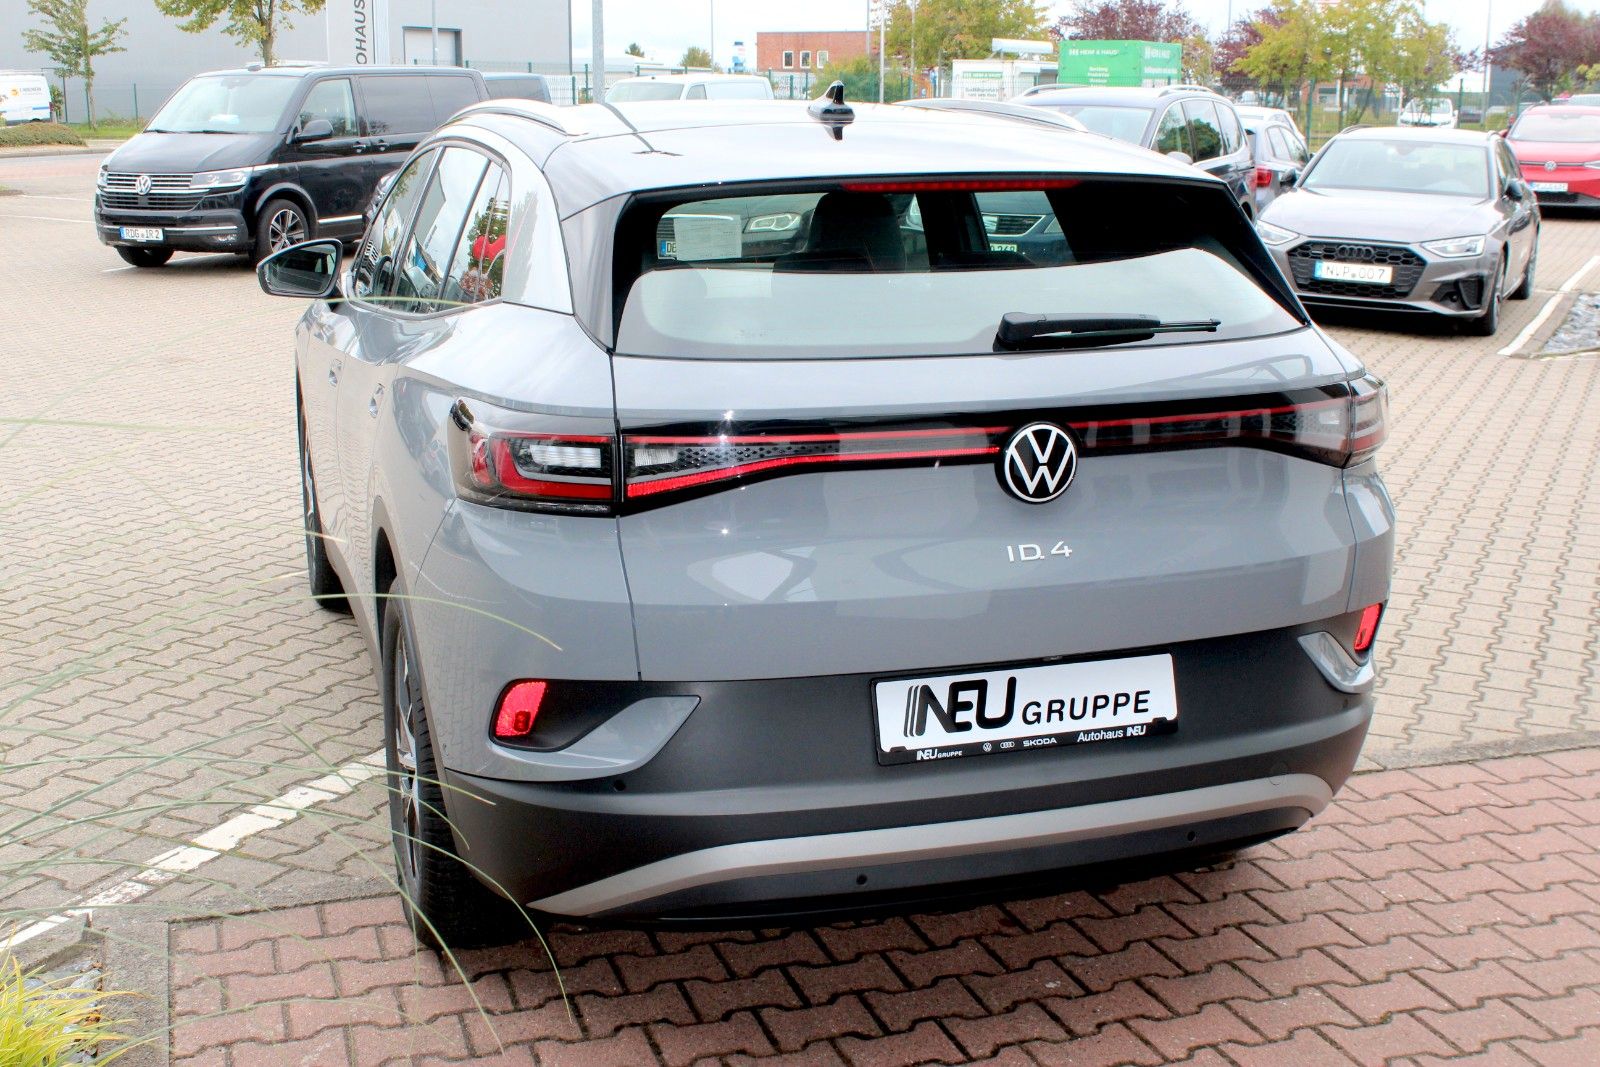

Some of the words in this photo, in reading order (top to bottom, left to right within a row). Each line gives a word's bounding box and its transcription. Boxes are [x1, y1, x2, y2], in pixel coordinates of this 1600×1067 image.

[903, 677, 1017, 737] NEU
[1022, 690, 1150, 725] GRUPPE
[1077, 729, 1124, 742] Autohaus
[1126, 725, 1147, 737] NEU
[937, 750, 963, 759] GRUPPE
